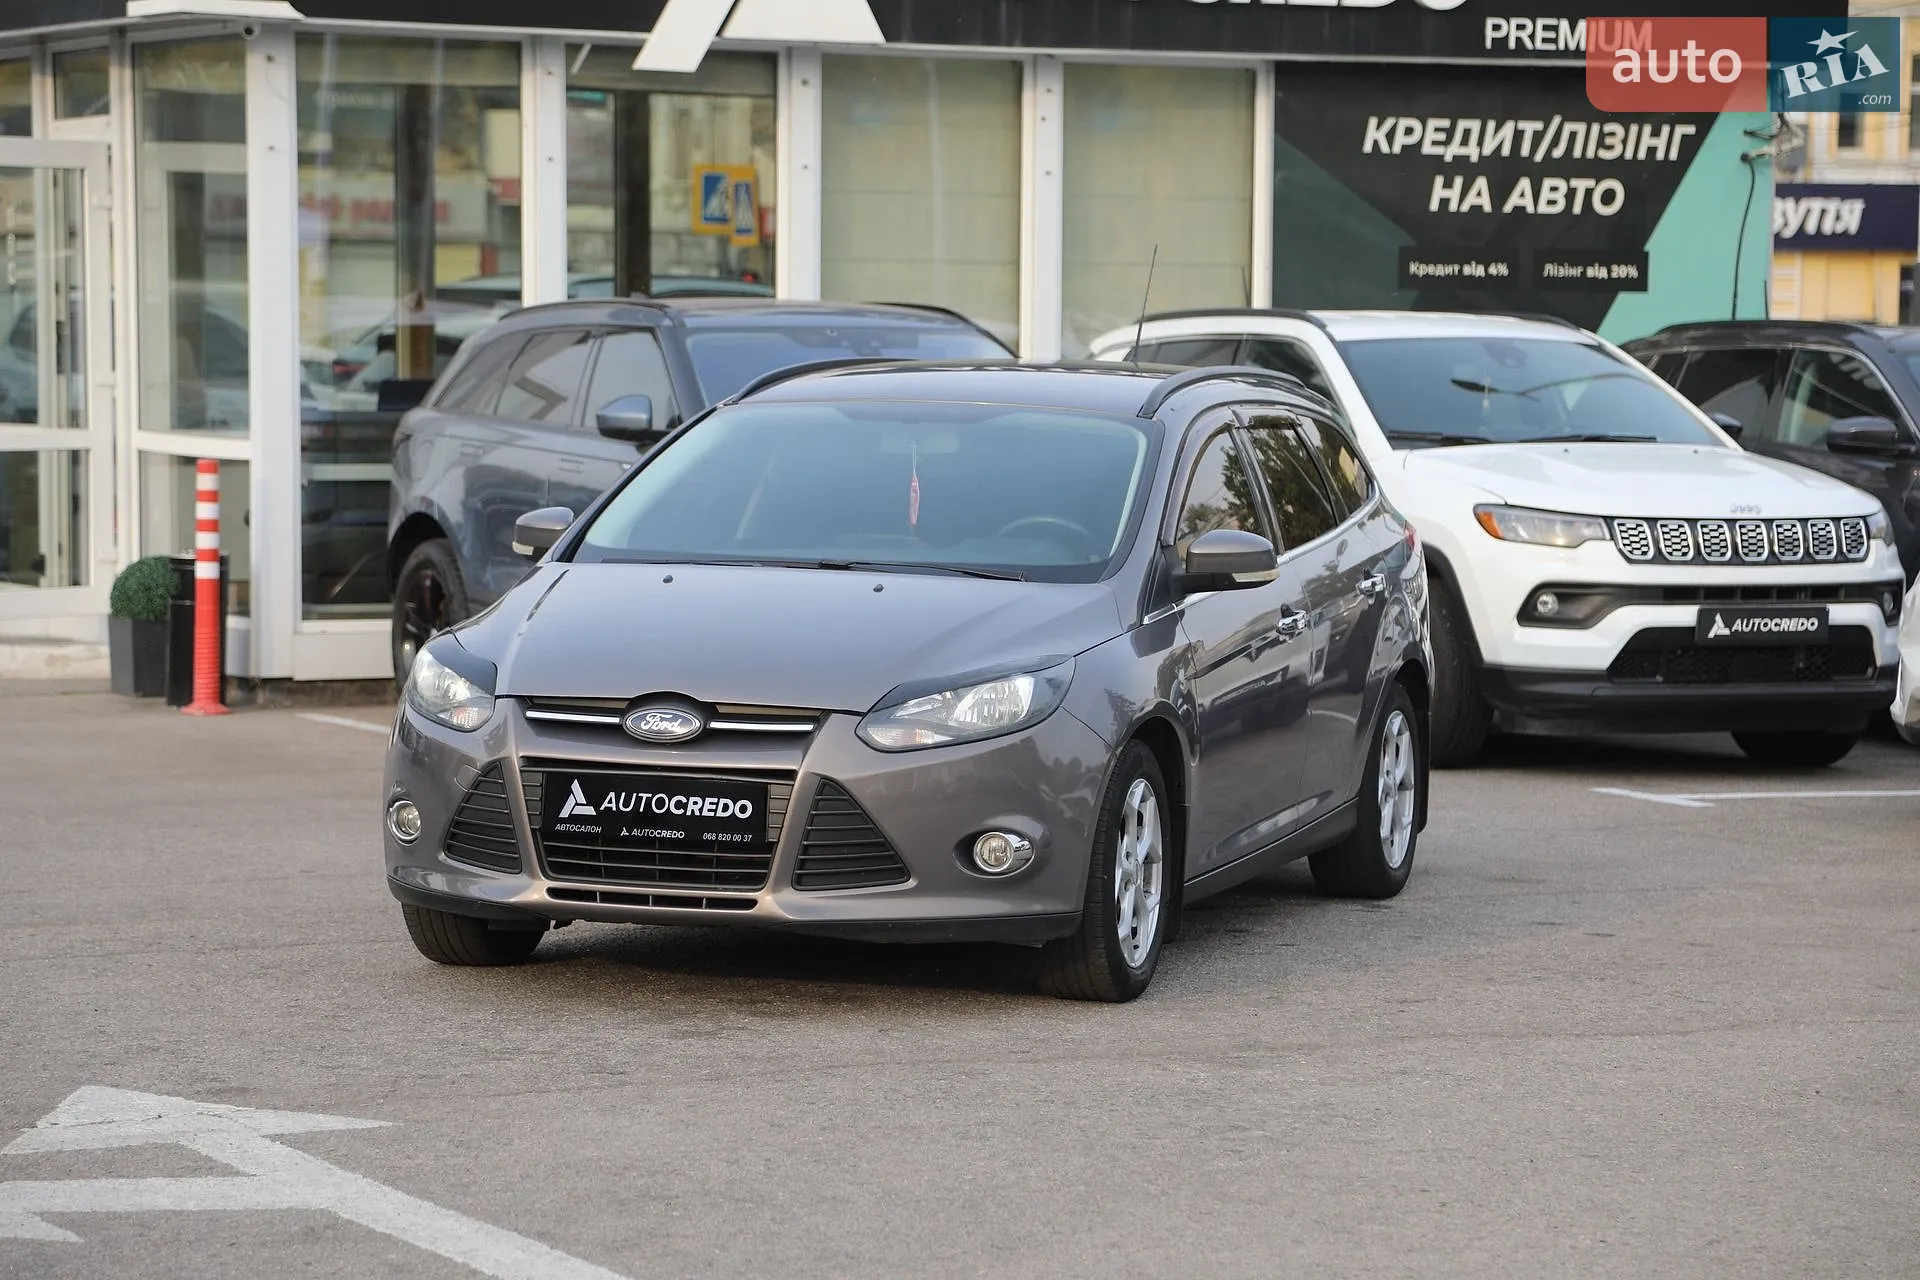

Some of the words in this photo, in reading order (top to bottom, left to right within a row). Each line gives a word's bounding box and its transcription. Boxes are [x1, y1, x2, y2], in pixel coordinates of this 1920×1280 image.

[1484, 17, 1653, 53] PREMIUM
[1362, 114, 1696, 163] КРЕДИТ/ЛІЗІНГ
[1428, 174, 1493, 213] НА
[1502, 176, 1626, 216] АВТО
[1408, 261, 1461, 278] Кредит
[1462, 261, 1486, 278] від
[1487, 262, 1509, 277] 4%
[1543, 262, 1584, 278] Лізінг
[1586, 263, 1609, 280] від
[1610, 264, 1639, 279] 20%
[1731, 617, 1819, 633] AUTOCREDO
[640, 713, 682, 731] Ford
[600, 791, 753, 819] AUTOCREDO
[555, 823, 602, 834] АВТОСАЛОН
[631, 828, 686, 840] AUTOCREDO
[702, 832, 716, 842] 068
[718, 832, 731, 842] 820
[732, 833, 742, 843] 00
[743, 833, 753, 843] 37
